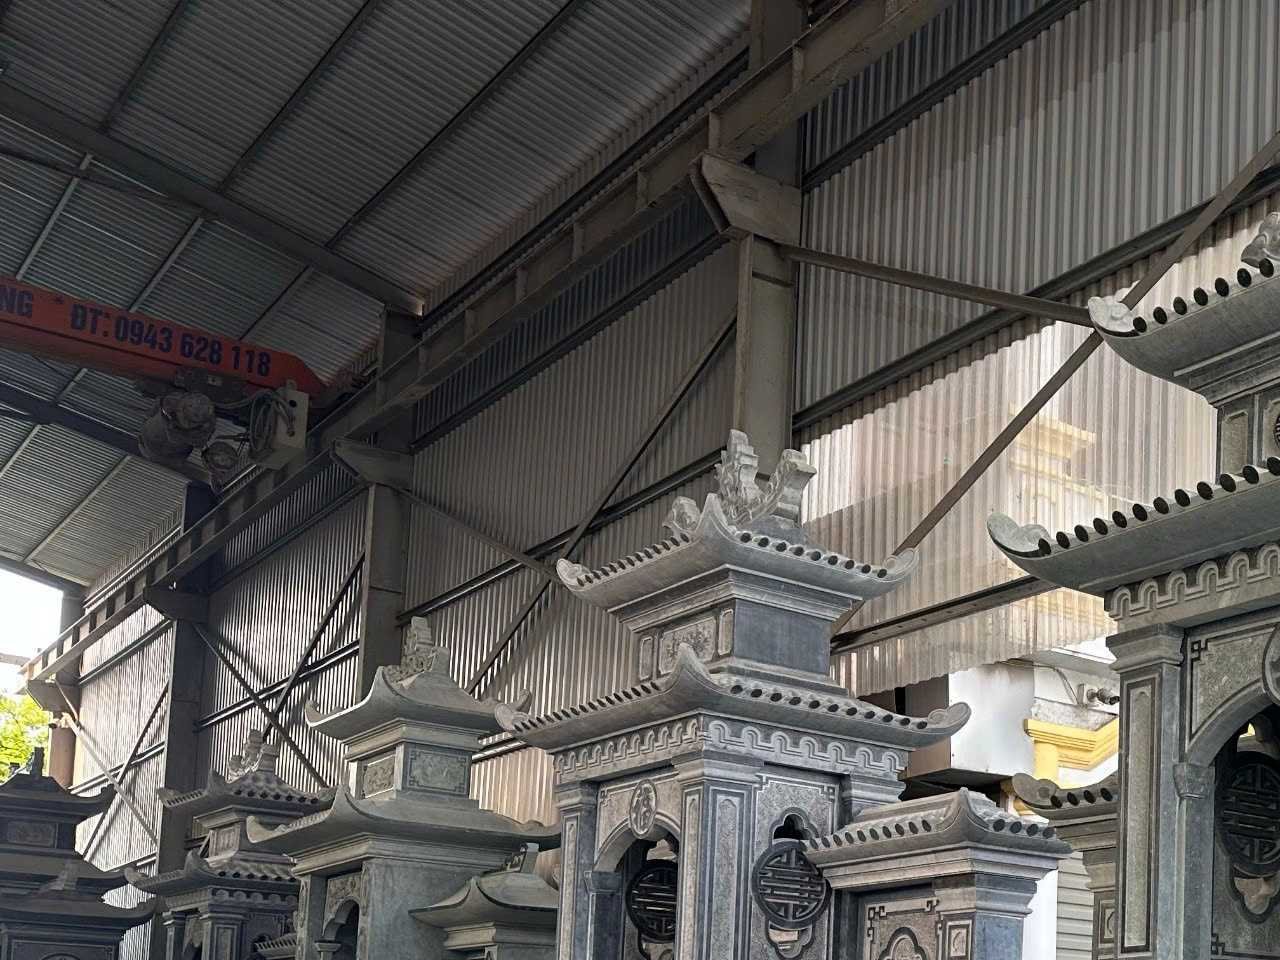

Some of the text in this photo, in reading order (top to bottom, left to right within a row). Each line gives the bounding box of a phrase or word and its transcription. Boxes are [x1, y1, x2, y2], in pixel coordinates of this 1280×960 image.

[114, 316, 173, 353] 0943
[180, 331, 222, 365] 628
[231, 346, 272, 377] 118
